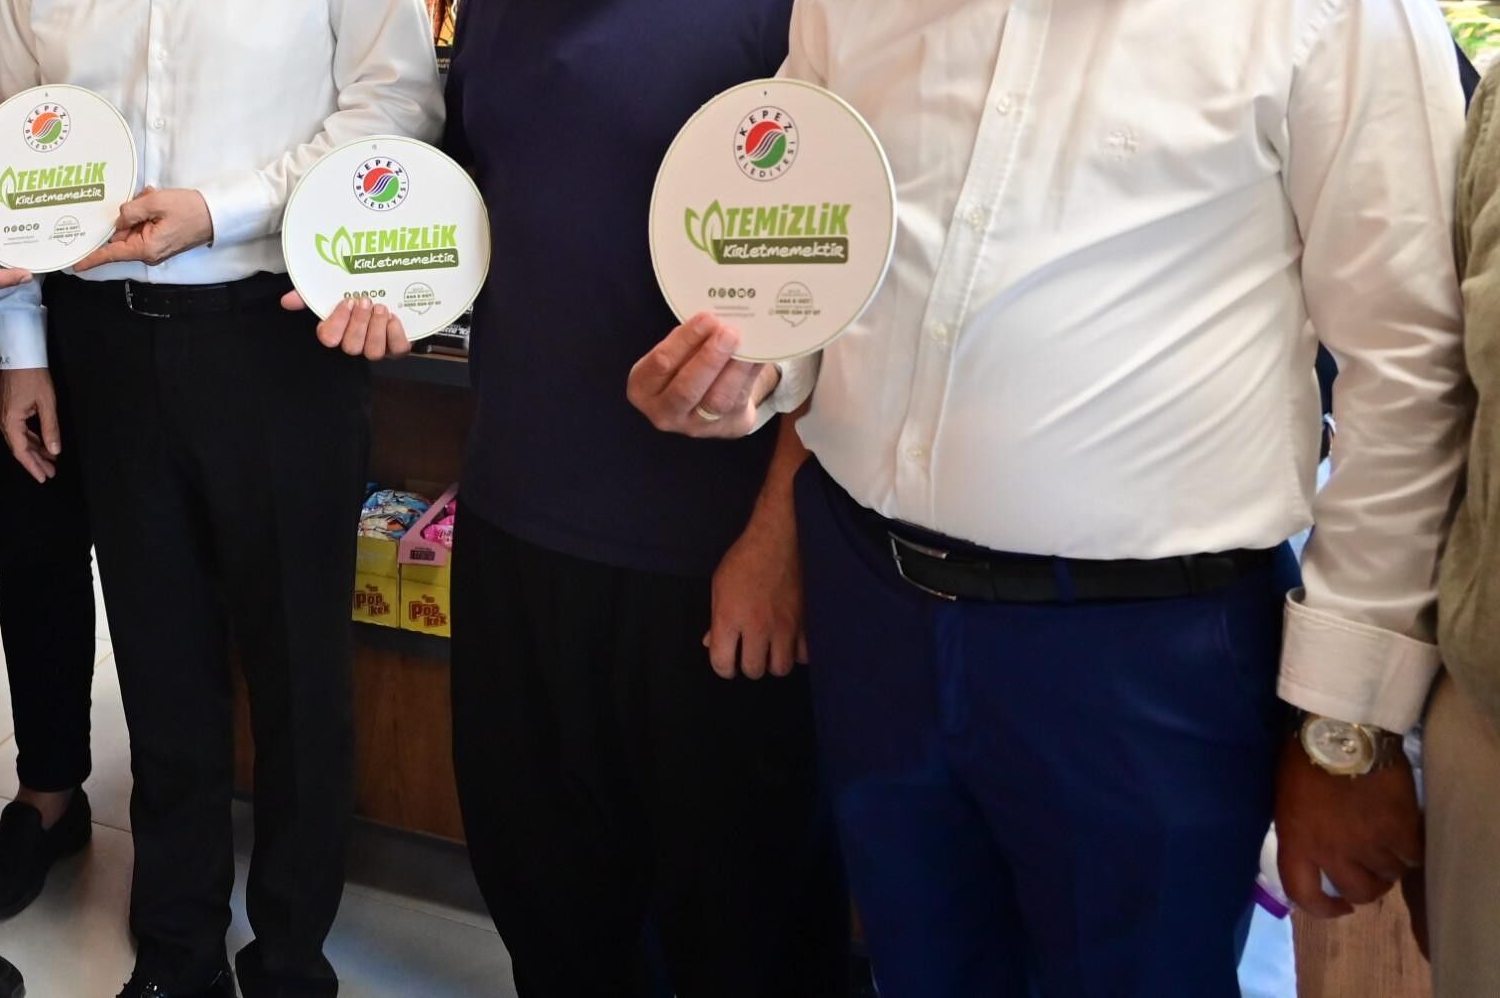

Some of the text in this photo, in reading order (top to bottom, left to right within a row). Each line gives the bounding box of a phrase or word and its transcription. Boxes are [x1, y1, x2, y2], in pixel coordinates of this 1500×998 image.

[27, 105, 66, 124] KEPEZ
[740, 110, 793, 137] KEPEZ
[357, 159, 403, 180] KEPEZ
